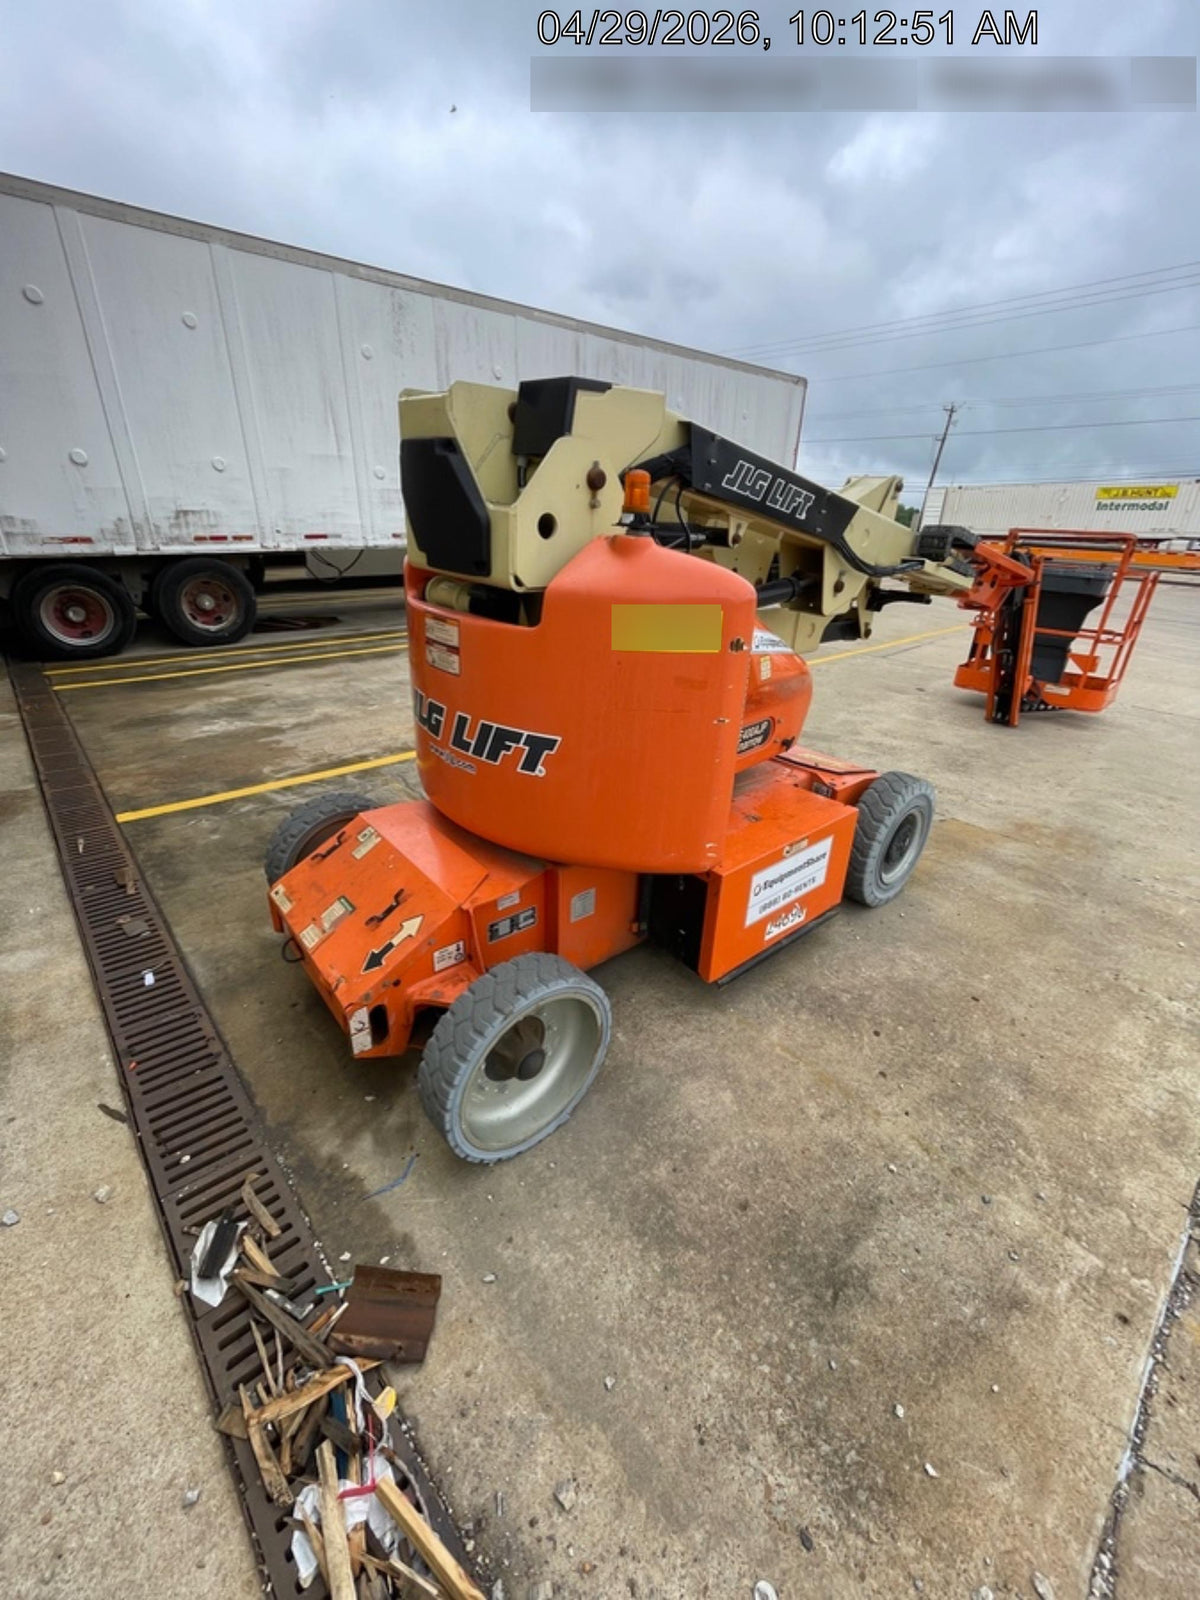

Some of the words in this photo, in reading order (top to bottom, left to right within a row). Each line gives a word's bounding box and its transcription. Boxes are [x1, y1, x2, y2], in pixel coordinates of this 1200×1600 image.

[721, 460, 773, 501] JLG
[766, 478, 815, 519] LIFT
[1095, 500, 1170, 511] Intermodal
[763, 851, 828, 890] EquipmentShare
